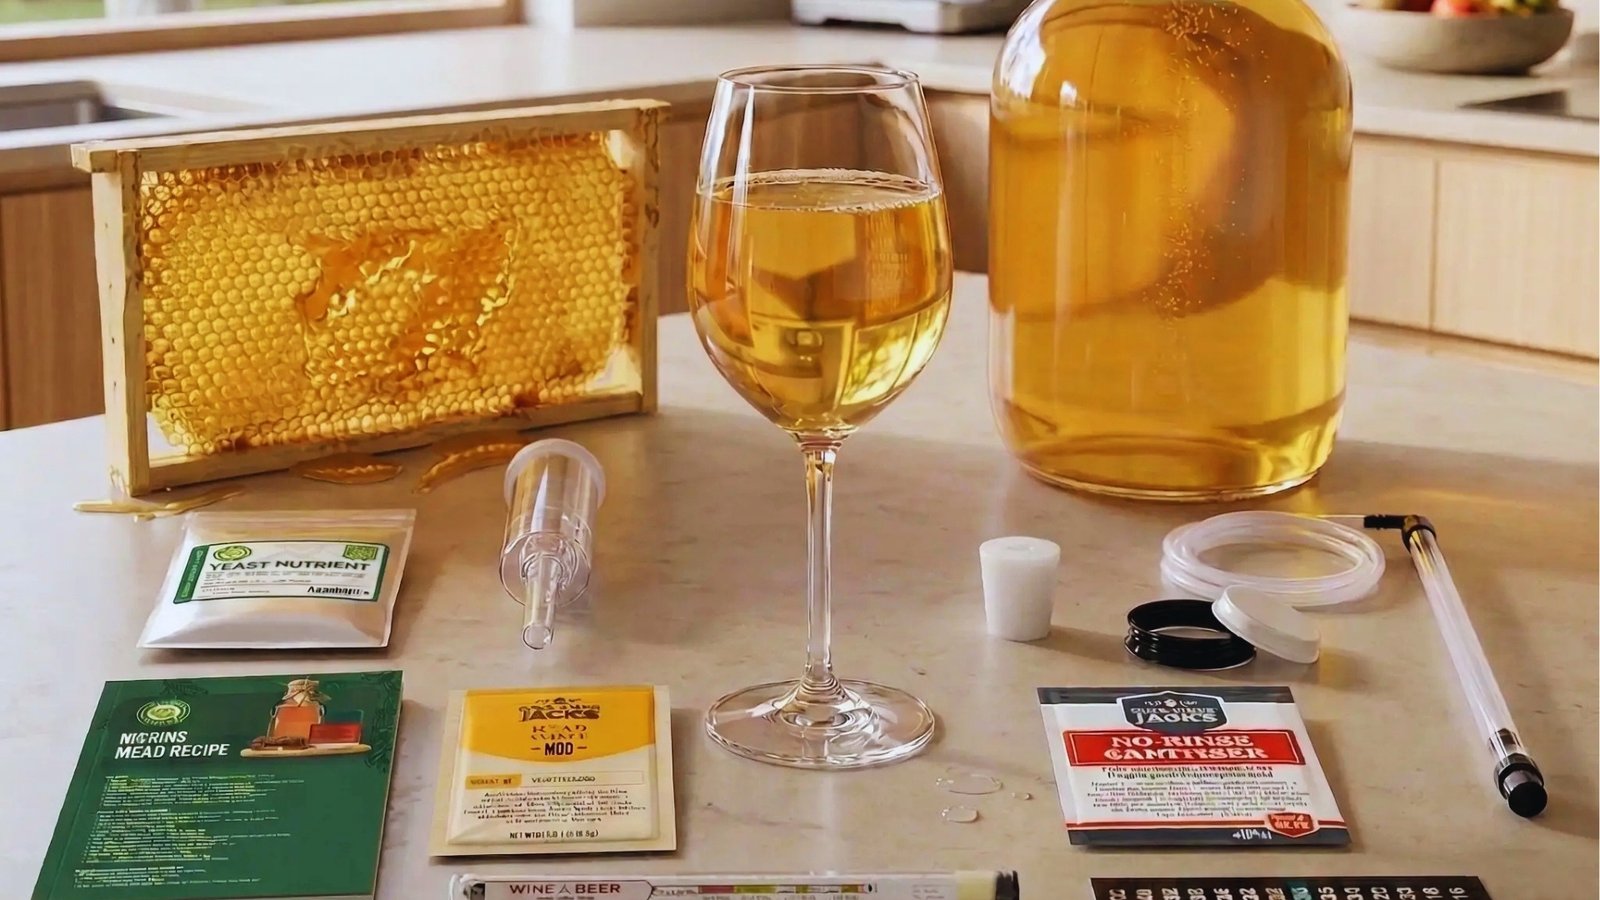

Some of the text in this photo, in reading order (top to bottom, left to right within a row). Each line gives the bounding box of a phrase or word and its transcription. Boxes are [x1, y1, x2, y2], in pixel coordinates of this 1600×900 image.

[210, 560, 371, 571] YEAST NUTRIENT
[1111, 735, 1255, 747] NO-RINSE
[115, 744, 230, 759] MEAD RECIPE
[545, 742, 573, 756] MOD
[510, 884, 555, 894] WINE
[575, 884, 621, 894] BEER
[1422, 887, 1443, 900] 18
[1449, 887, 1468, 900] 16
